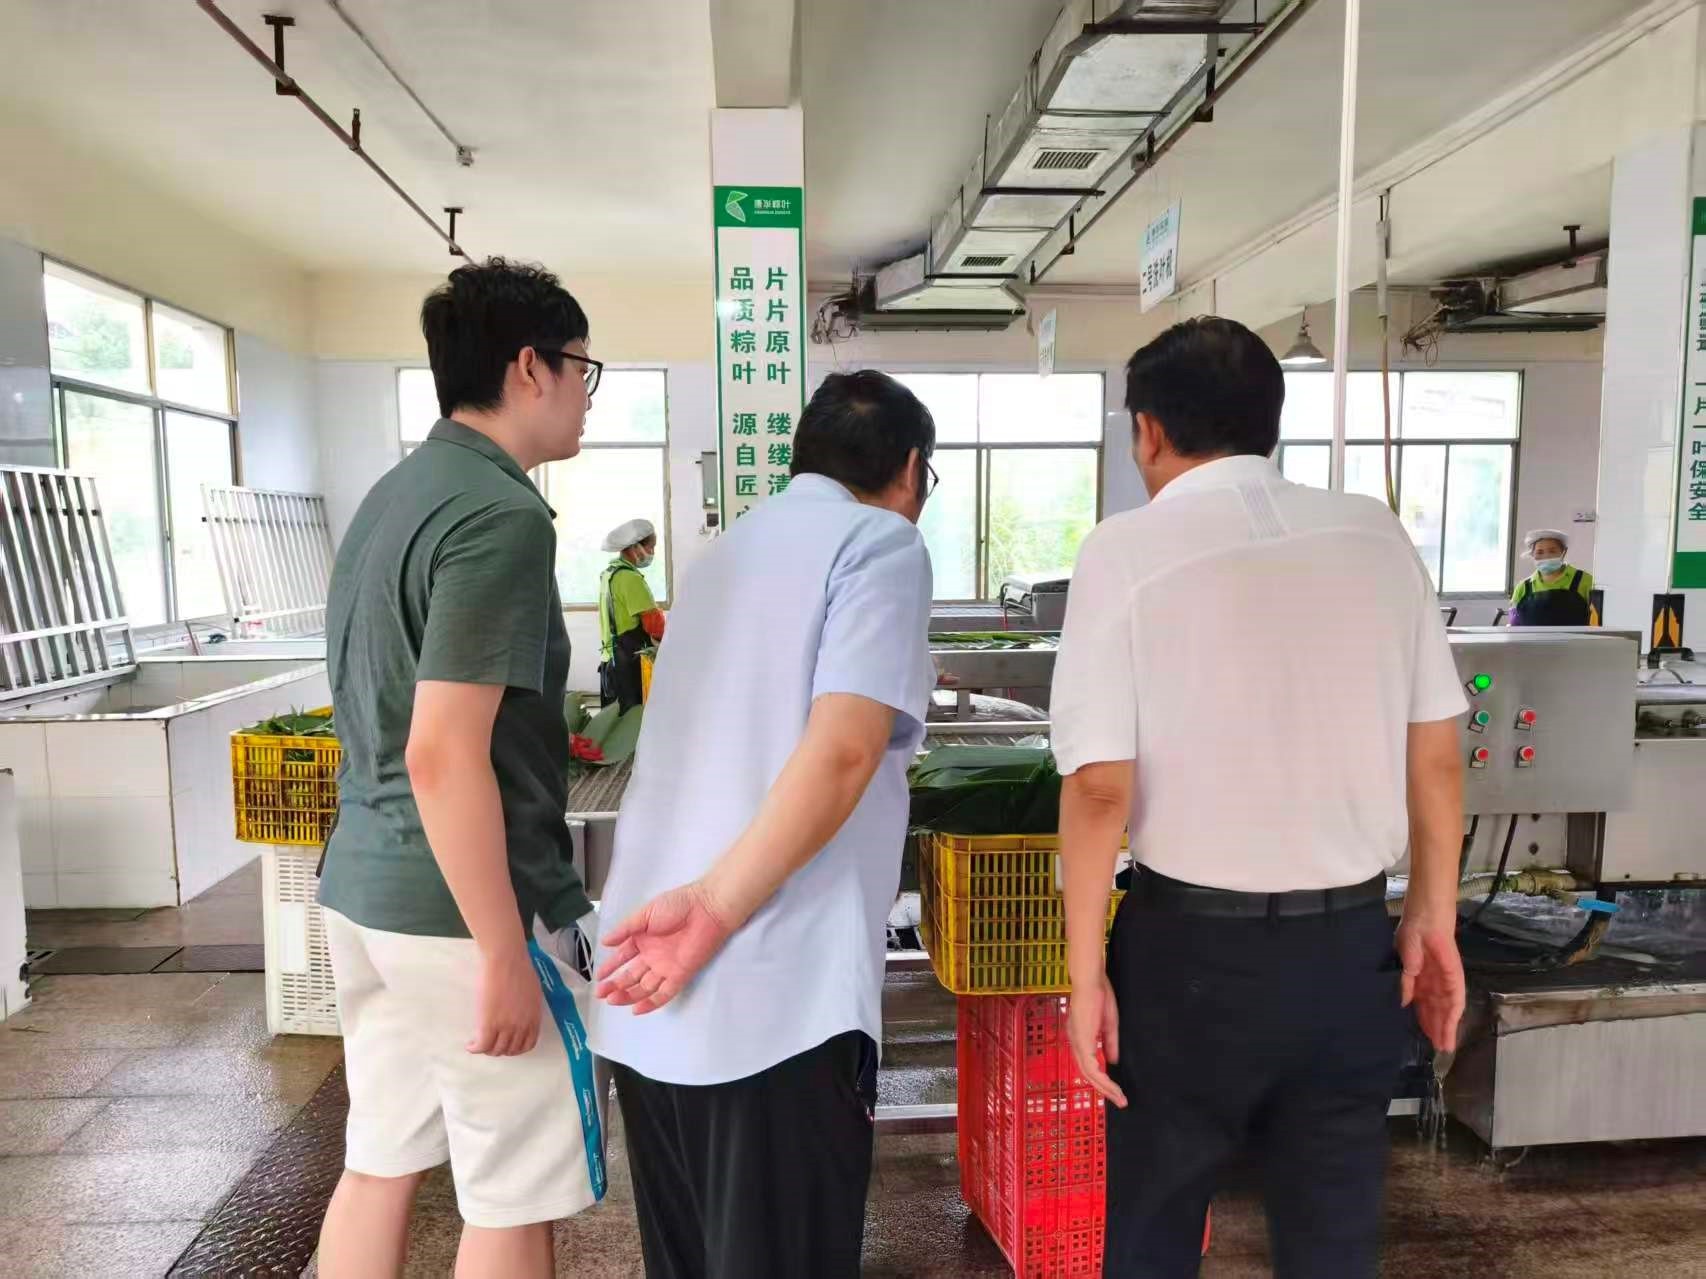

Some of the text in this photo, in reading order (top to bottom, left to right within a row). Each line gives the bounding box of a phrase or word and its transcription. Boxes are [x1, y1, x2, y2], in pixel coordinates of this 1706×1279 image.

[765, 266, 792, 385] 片片原叶
[732, 412, 759, 520] 源自匠
